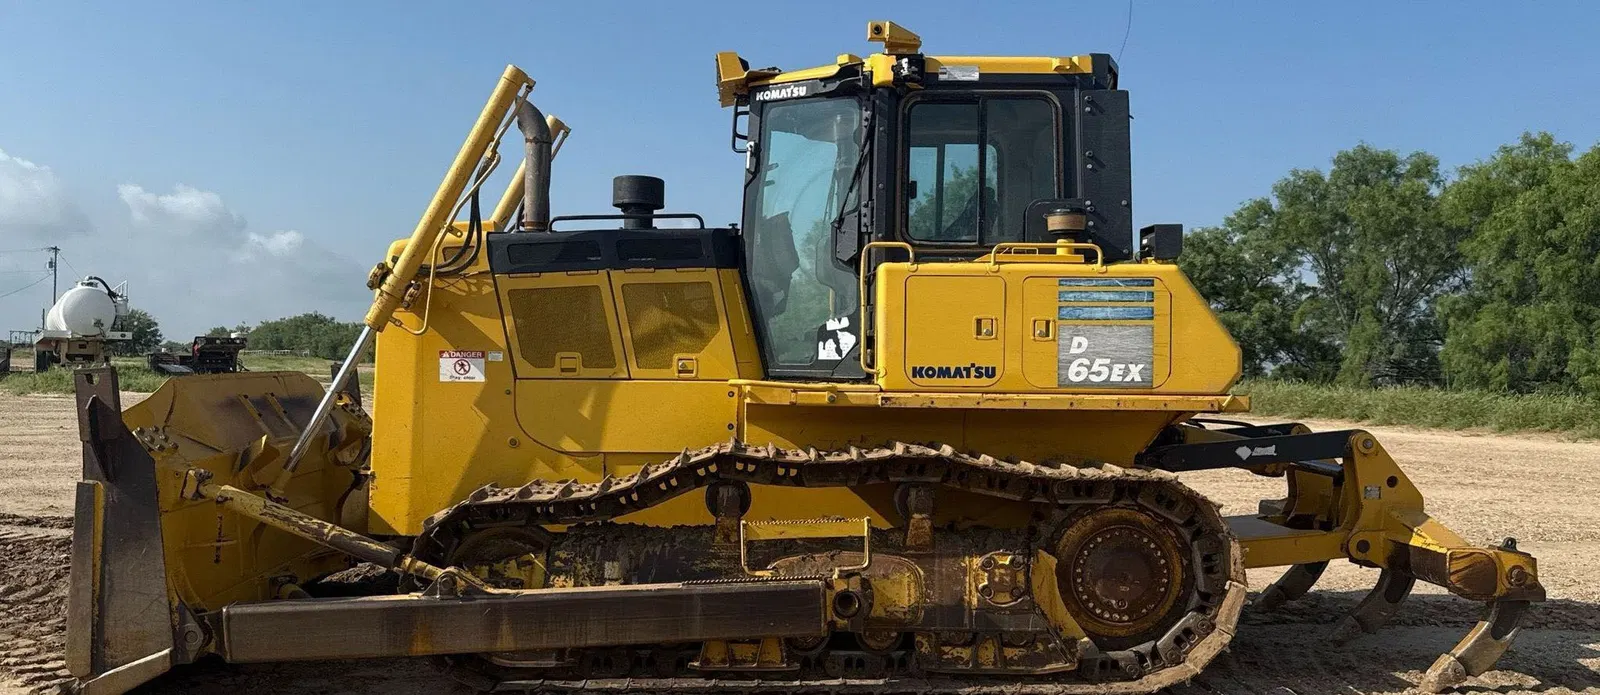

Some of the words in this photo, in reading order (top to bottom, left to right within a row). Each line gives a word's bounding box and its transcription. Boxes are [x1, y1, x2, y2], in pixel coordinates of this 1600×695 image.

[756, 85, 806, 101] KOMATSU
[1069, 336, 1089, 354] D
[912, 363, 996, 379] KOMATSU
[1068, 358, 1145, 382] 65EX
